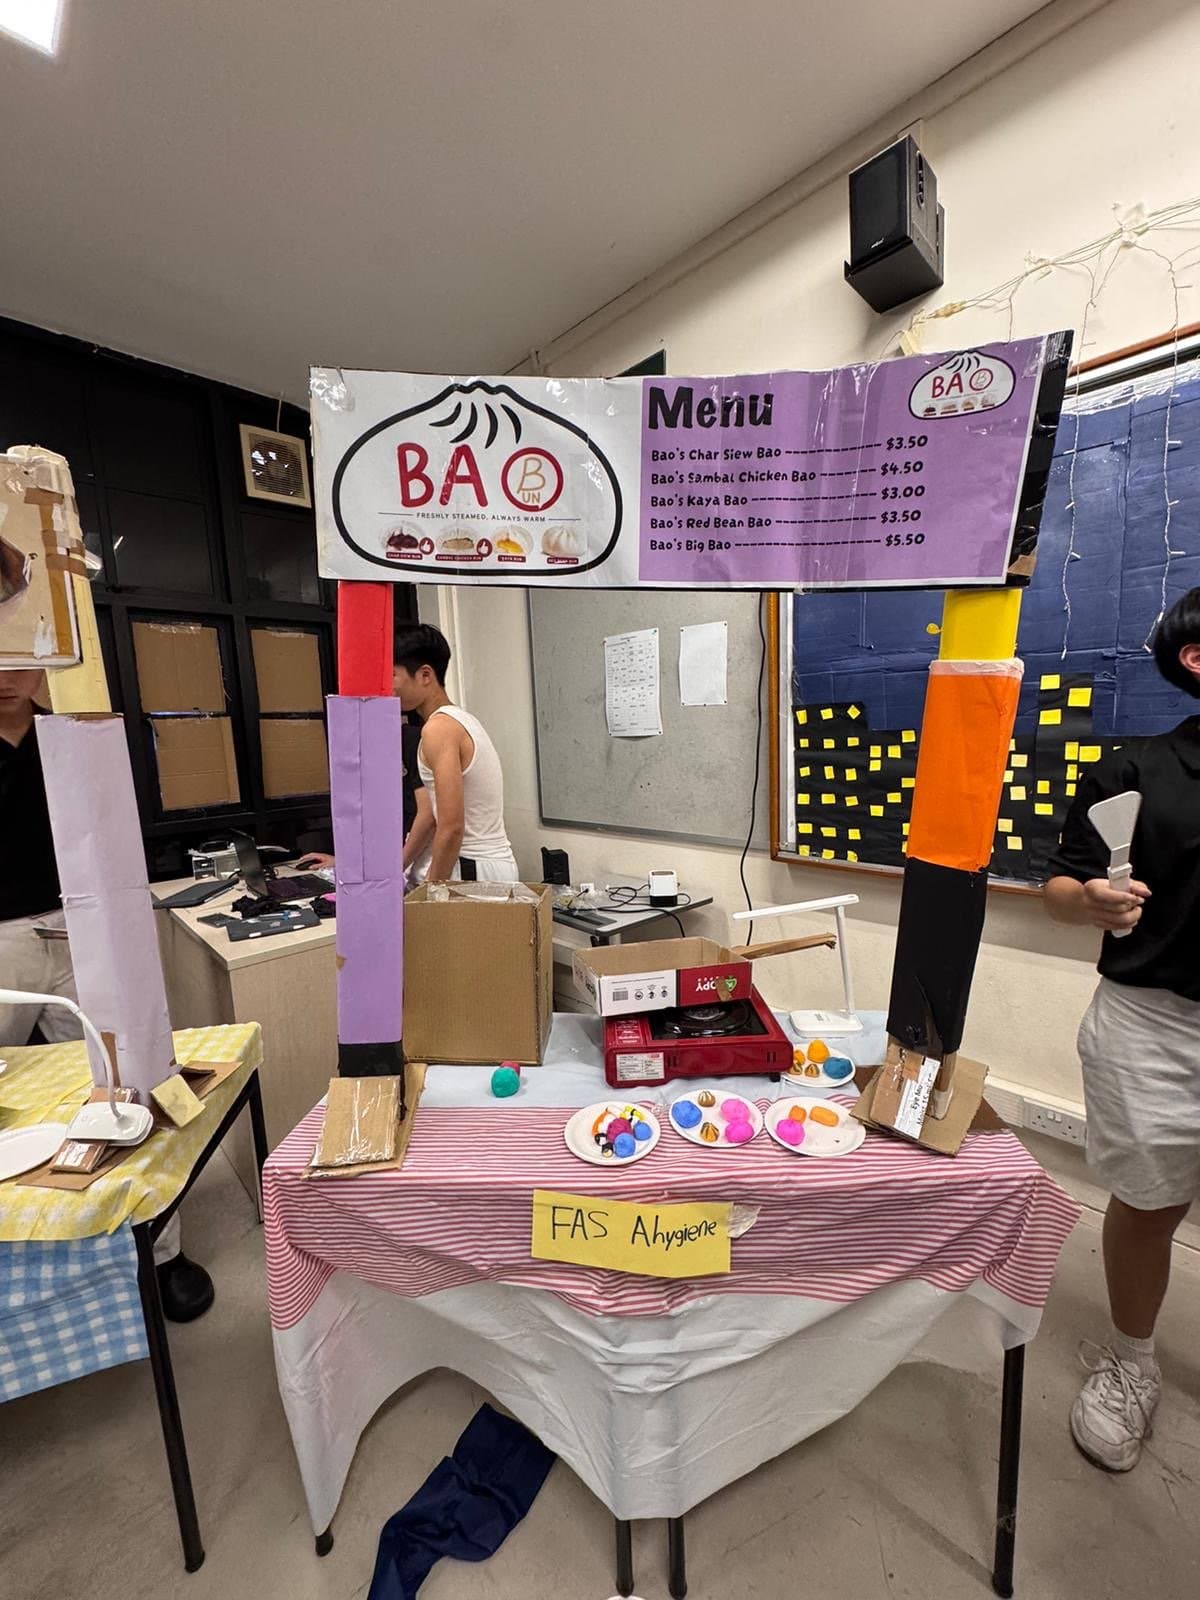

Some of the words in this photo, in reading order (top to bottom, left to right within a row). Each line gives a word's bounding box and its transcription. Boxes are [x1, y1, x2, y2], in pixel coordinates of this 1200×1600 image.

[931, 368, 994, 399] BAO
[648, 386, 774, 430] Menu
[651, 448, 685, 462] Bao's
[689, 448, 720, 461] Char
[723, 448, 753, 461] Siew
[756, 446, 782, 459] Bao
[886, 435, 929, 451] $3.50
[651, 471, 685, 485] Bao's
[687, 471, 735, 484] Sambal
[738, 470, 788, 483] Chicken
[791, 470, 817, 482] Bao
[880, 460, 924, 476] $4.50
[651, 494, 684, 508] Bao's
[686, 495, 718, 508] Kaya
[723, 495, 748, 506] Bao
[881, 484, 926, 501] $3.00
[416, 512, 450, 520] FRESHLY
[491, 514, 521, 522] ALWAYS
[650, 516, 683, 529] Bao's
[686, 516, 710, 529] Red
[713, 517, 745, 529] Bean
[747, 516, 772, 529] Bao
[880, 509, 922, 525] $3.50
[650, 538, 683, 551] Bao's
[685, 539, 705, 553] Big
[707, 539, 732, 551] Bao
[885, 532, 926, 547] $5.50
[551, 1205, 609, 1240] FAS
[631, 1214, 717, 1251] Ahygiene
